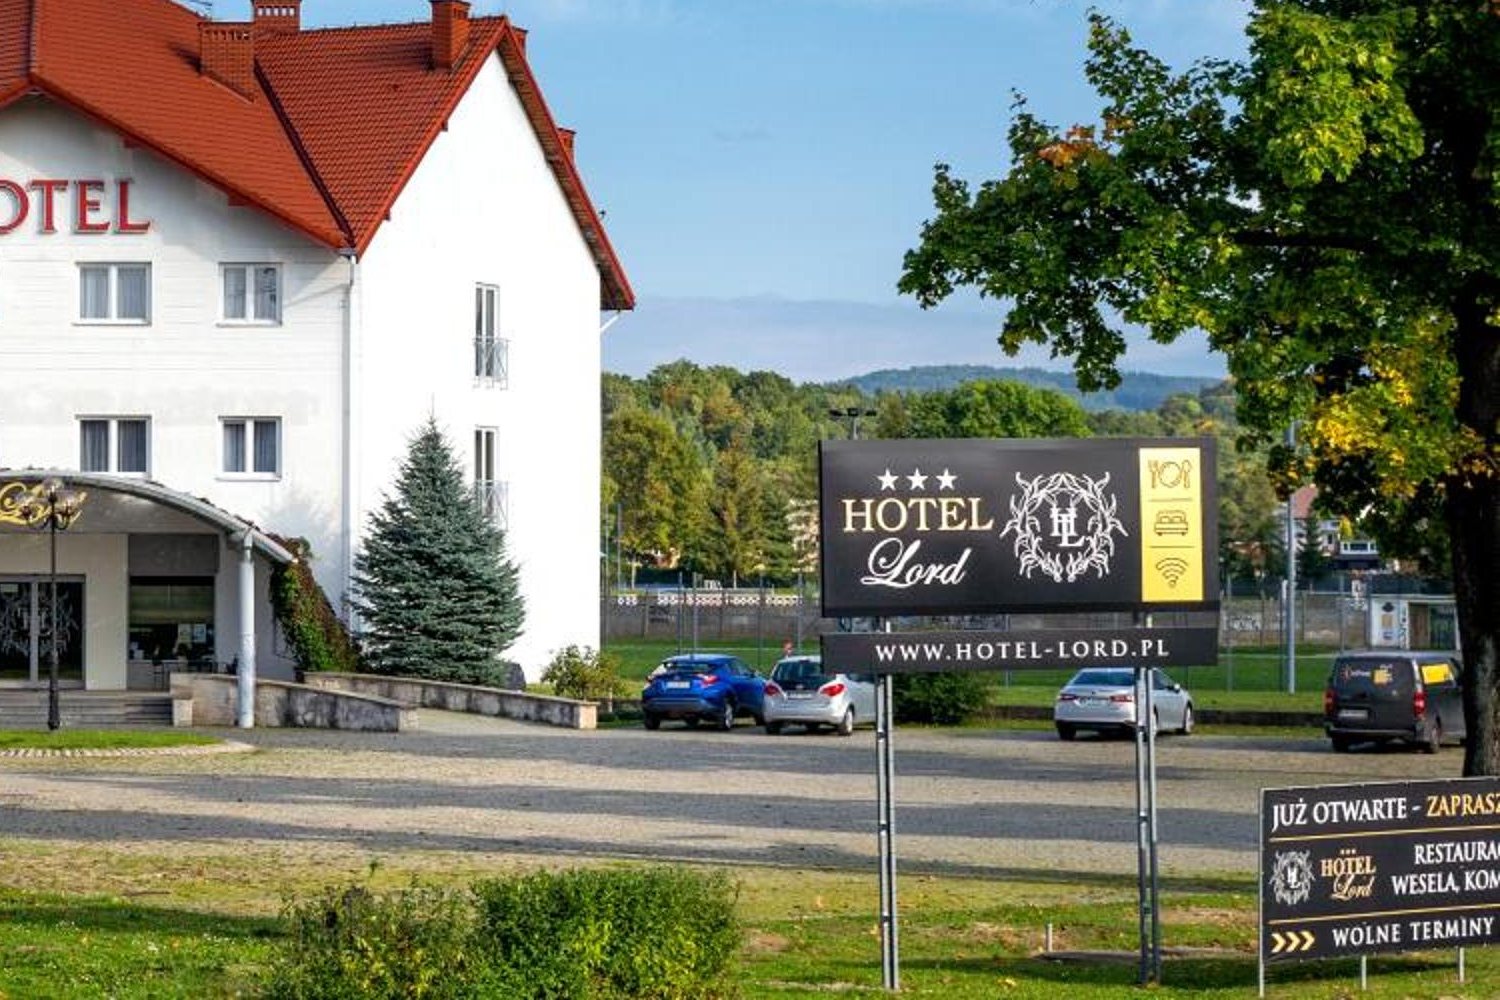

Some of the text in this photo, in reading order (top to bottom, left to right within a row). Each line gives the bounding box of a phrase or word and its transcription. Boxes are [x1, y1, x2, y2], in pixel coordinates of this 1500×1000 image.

[841, 497, 995, 533] HOTEL
[860, 536, 973, 589] Lord
[875, 639, 1170, 662] WWW.HOTEL-LORD.PL
[1271, 798, 1308, 833] JUŻ
[1312, 797, 1407, 825] OTWARTE
[1320, 855, 1377, 877] HOTEL
[1330, 873, 1375, 900] Lord
[1391, 872, 1461, 896] WESELA,
[1332, 916, 1494, 948] WOLNE TERMINY
